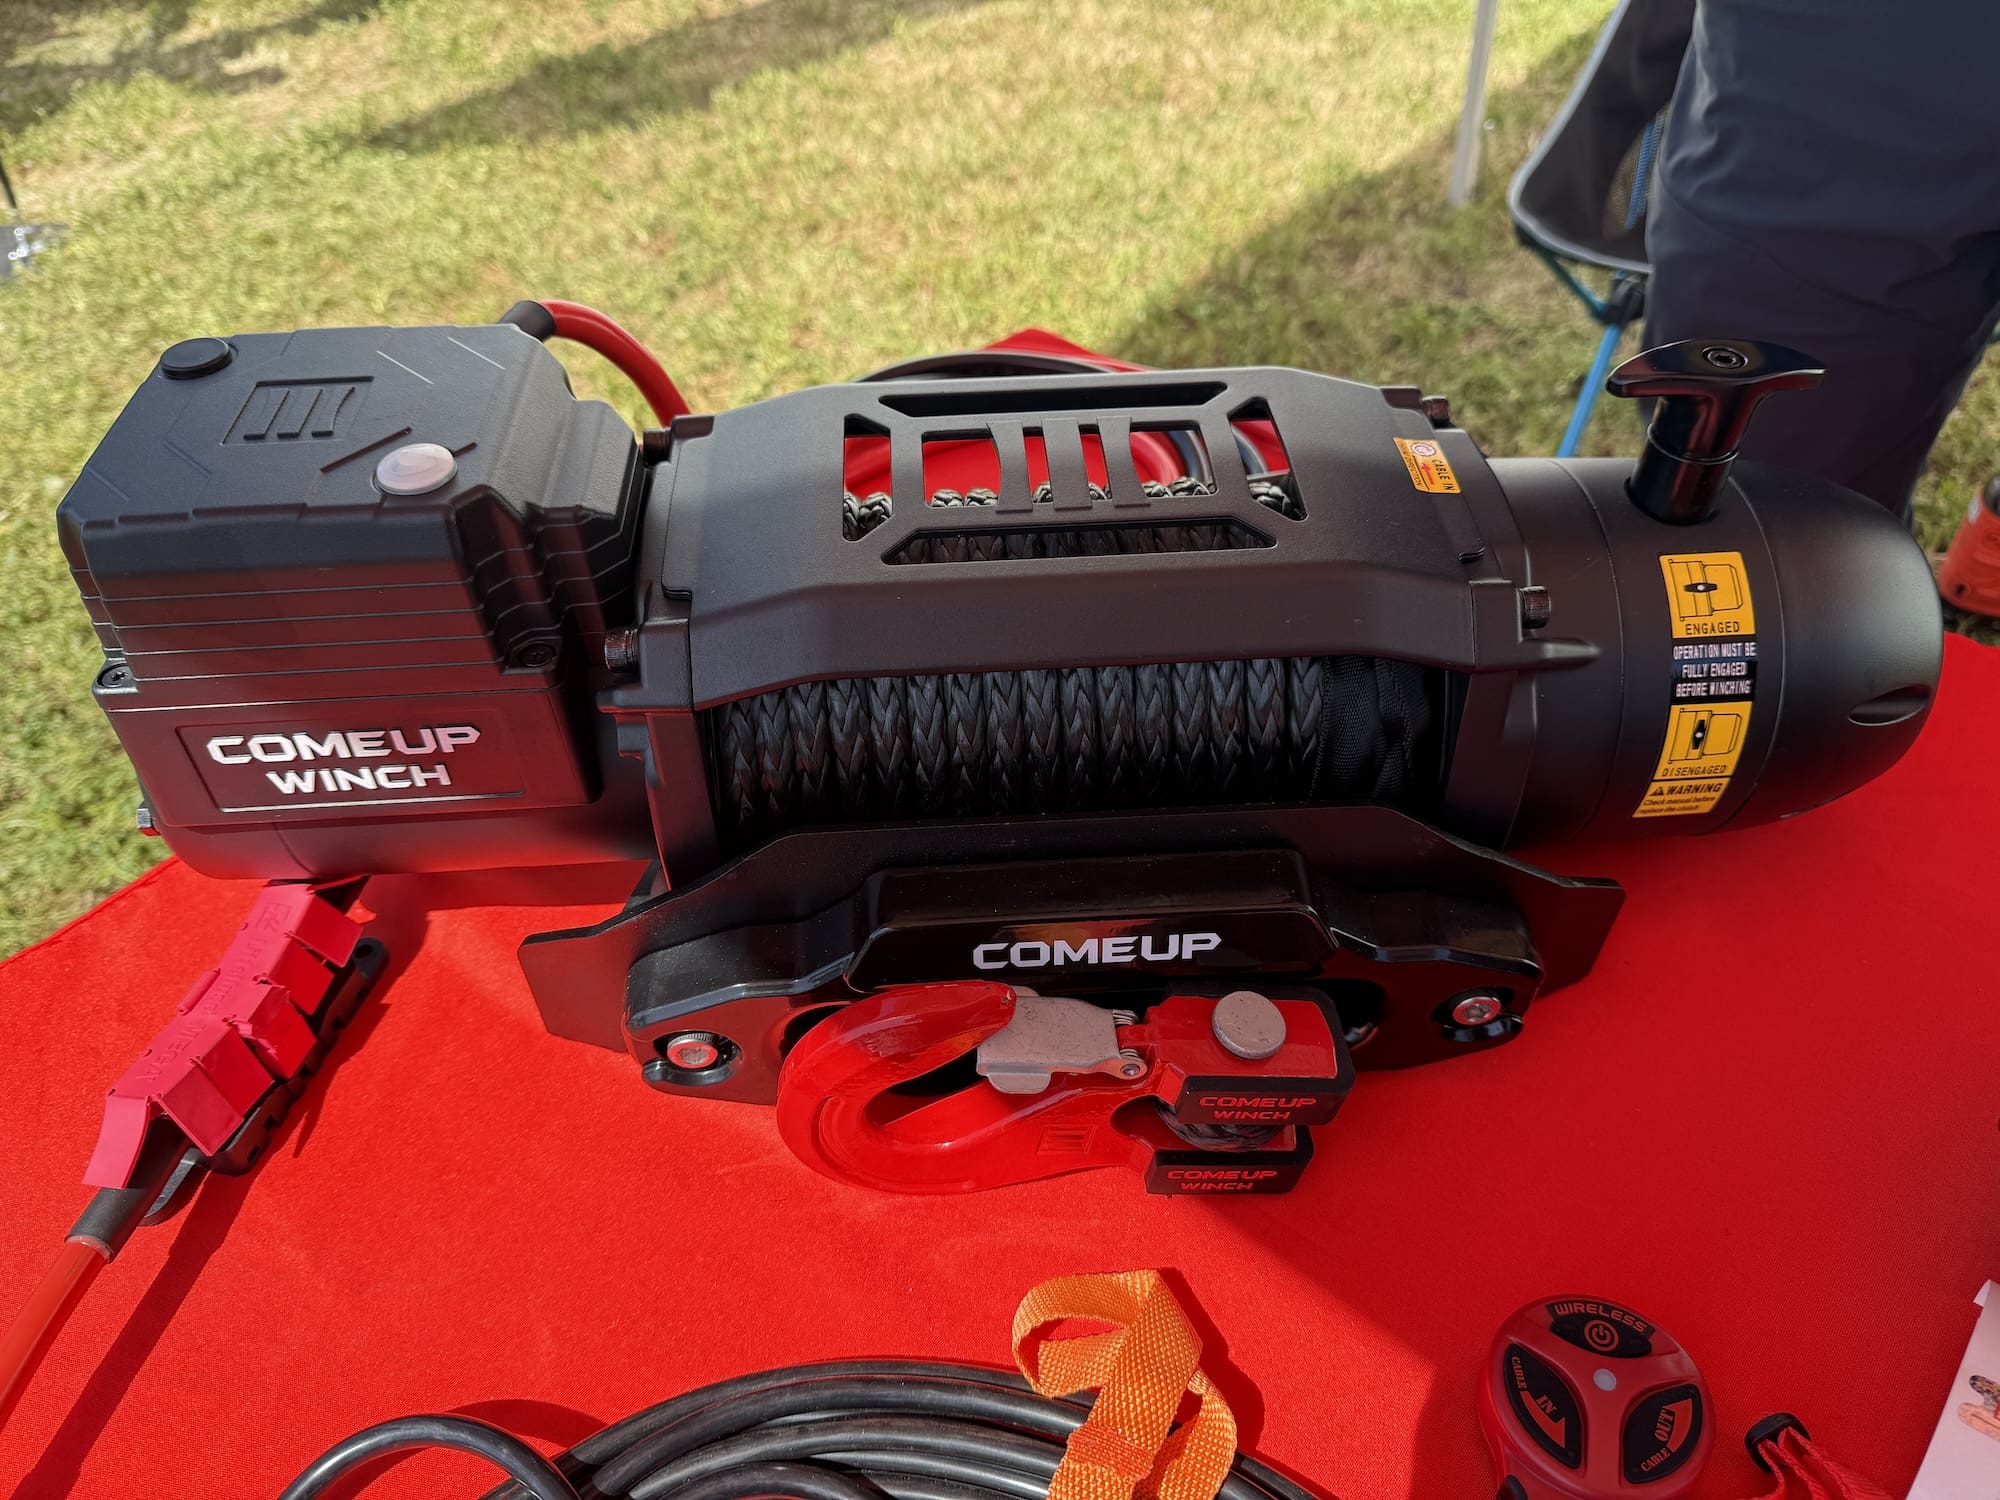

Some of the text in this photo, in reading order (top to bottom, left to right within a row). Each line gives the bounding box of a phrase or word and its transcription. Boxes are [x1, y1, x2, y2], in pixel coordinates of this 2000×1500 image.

[1432, 460, 1456, 491] CABLE IN
[1685, 621, 1740, 636] ENGAGED
[1673, 642, 1757, 660] OPERATION MUST BE
[1682, 661, 1747, 678] FULLY ENGAGED
[1676, 680, 1752, 697] BEFORE WINCHING
[206, 726, 481, 765] COMEUP
[265, 764, 452, 795] WINCH
[1661, 764, 1727, 777] DISENGAGED
[1666, 783, 1723, 796] WARNING
[973, 932, 1223, 970] COMEUP
[1200, 1096, 1317, 1108] COMEUP
[1213, 1110, 1291, 1120] WINCH
[1167, 1170, 1278, 1180] COMEUP
[1180, 1182, 1254, 1191] WINCH
[1554, 1302, 1648, 1333] WIRELESS
[1511, 1356, 1527, 1389] CABLE
[1536, 1394, 1558, 1414] IN
[1655, 1409, 1675, 1442] OUT
[1640, 1447, 1671, 1473] CABLE
